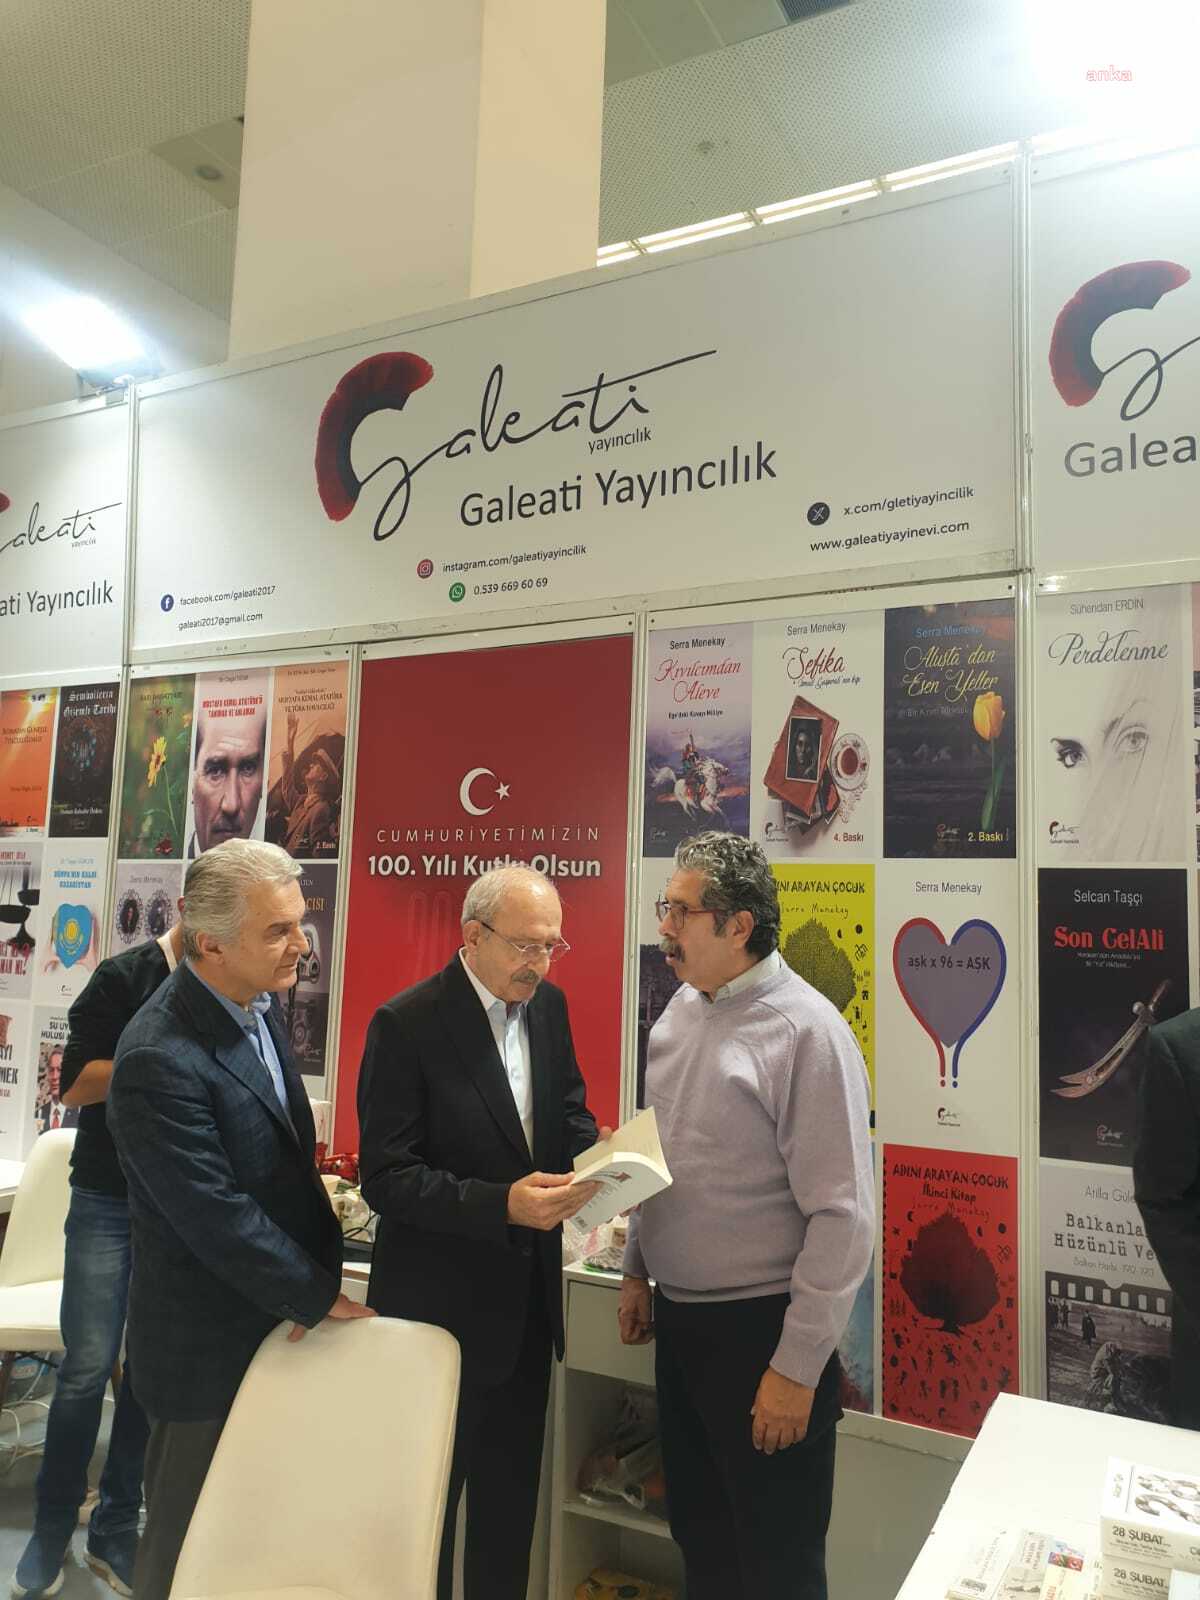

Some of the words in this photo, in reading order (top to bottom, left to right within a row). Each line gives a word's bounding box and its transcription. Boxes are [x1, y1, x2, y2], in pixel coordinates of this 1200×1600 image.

[588, 427, 652, 455] yayıncılık
[1064, 432, 1197, 478] Galea
[460, 475, 583, 527] Galeati
[596, 441, 777, 508] Yayıncılık
[844, 486, 974, 515] x.com/gletiyayincilik
[0, 501, 122, 552] aleati
[810, 521, 970, 552] www.galeatiyayinevi.com
[442, 545, 587, 573] instagram.com/galeatiyayincilik
[180, 585, 276, 606] facebook.com/galeati2017
[473, 584, 499, 596] 0.539
[501, 581, 518, 592] 669
[521, 578, 534, 590] 60
[535, 577, 549, 589] 69
[0, 592, 21, 617] ati
[27, 579, 113, 617] Yayıncılık
[178, 612, 263, 631] galeati2017@gmail.com
[787, 625, 808, 636] Serra
[810, 622, 847, 635] Menekay
[915, 627, 943, 638] Serra
[669, 641, 689, 650] Serra
[691, 637, 726, 649] Menekay
[1048, 630, 1168, 665] Perdelenme
[377, 824, 599, 843] CUMHURİYETİMİZİN
[834, 834, 841, 842] 4.
[843, 832, 863, 843] Baskı
[979, 831, 1003, 842] Baskı
[369, 855, 416, 876] 100.
[422, 854, 457, 876] Yılı
[530, 853, 600, 877] Olsun
[791, 881, 830, 892] ARAYAN
[831, 881, 865, 894] ÇOCUK
[915, 881, 939, 893] Serra
[941, 881, 982, 895] Menekay
[1073, 889, 1110, 903] Selcan
[1113, 890, 1143, 907] Taşçı
[1054, 926, 1093, 949] Son
[930, 957, 937, 968] x
[940, 955, 953, 969] 96
[966, 956, 992, 972] AŞK
[49, 1021, 58, 1030] SU
[59, 1022, 70, 1031] UY
[923, 1167, 970, 1184] ARAYAN
[970, 1172, 1009, 1189] ÇOCUK
[950, 1188, 977, 1204] Kitap
[1066, 1213, 1144, 1237] Balkanla
[1054, 1233, 1128, 1257] Hüzünlü
[1134, 1244, 1155, 1261] Ve
[1112, 1525, 1125, 1537] 28
[1113, 1567, 1127, 1579] 28
